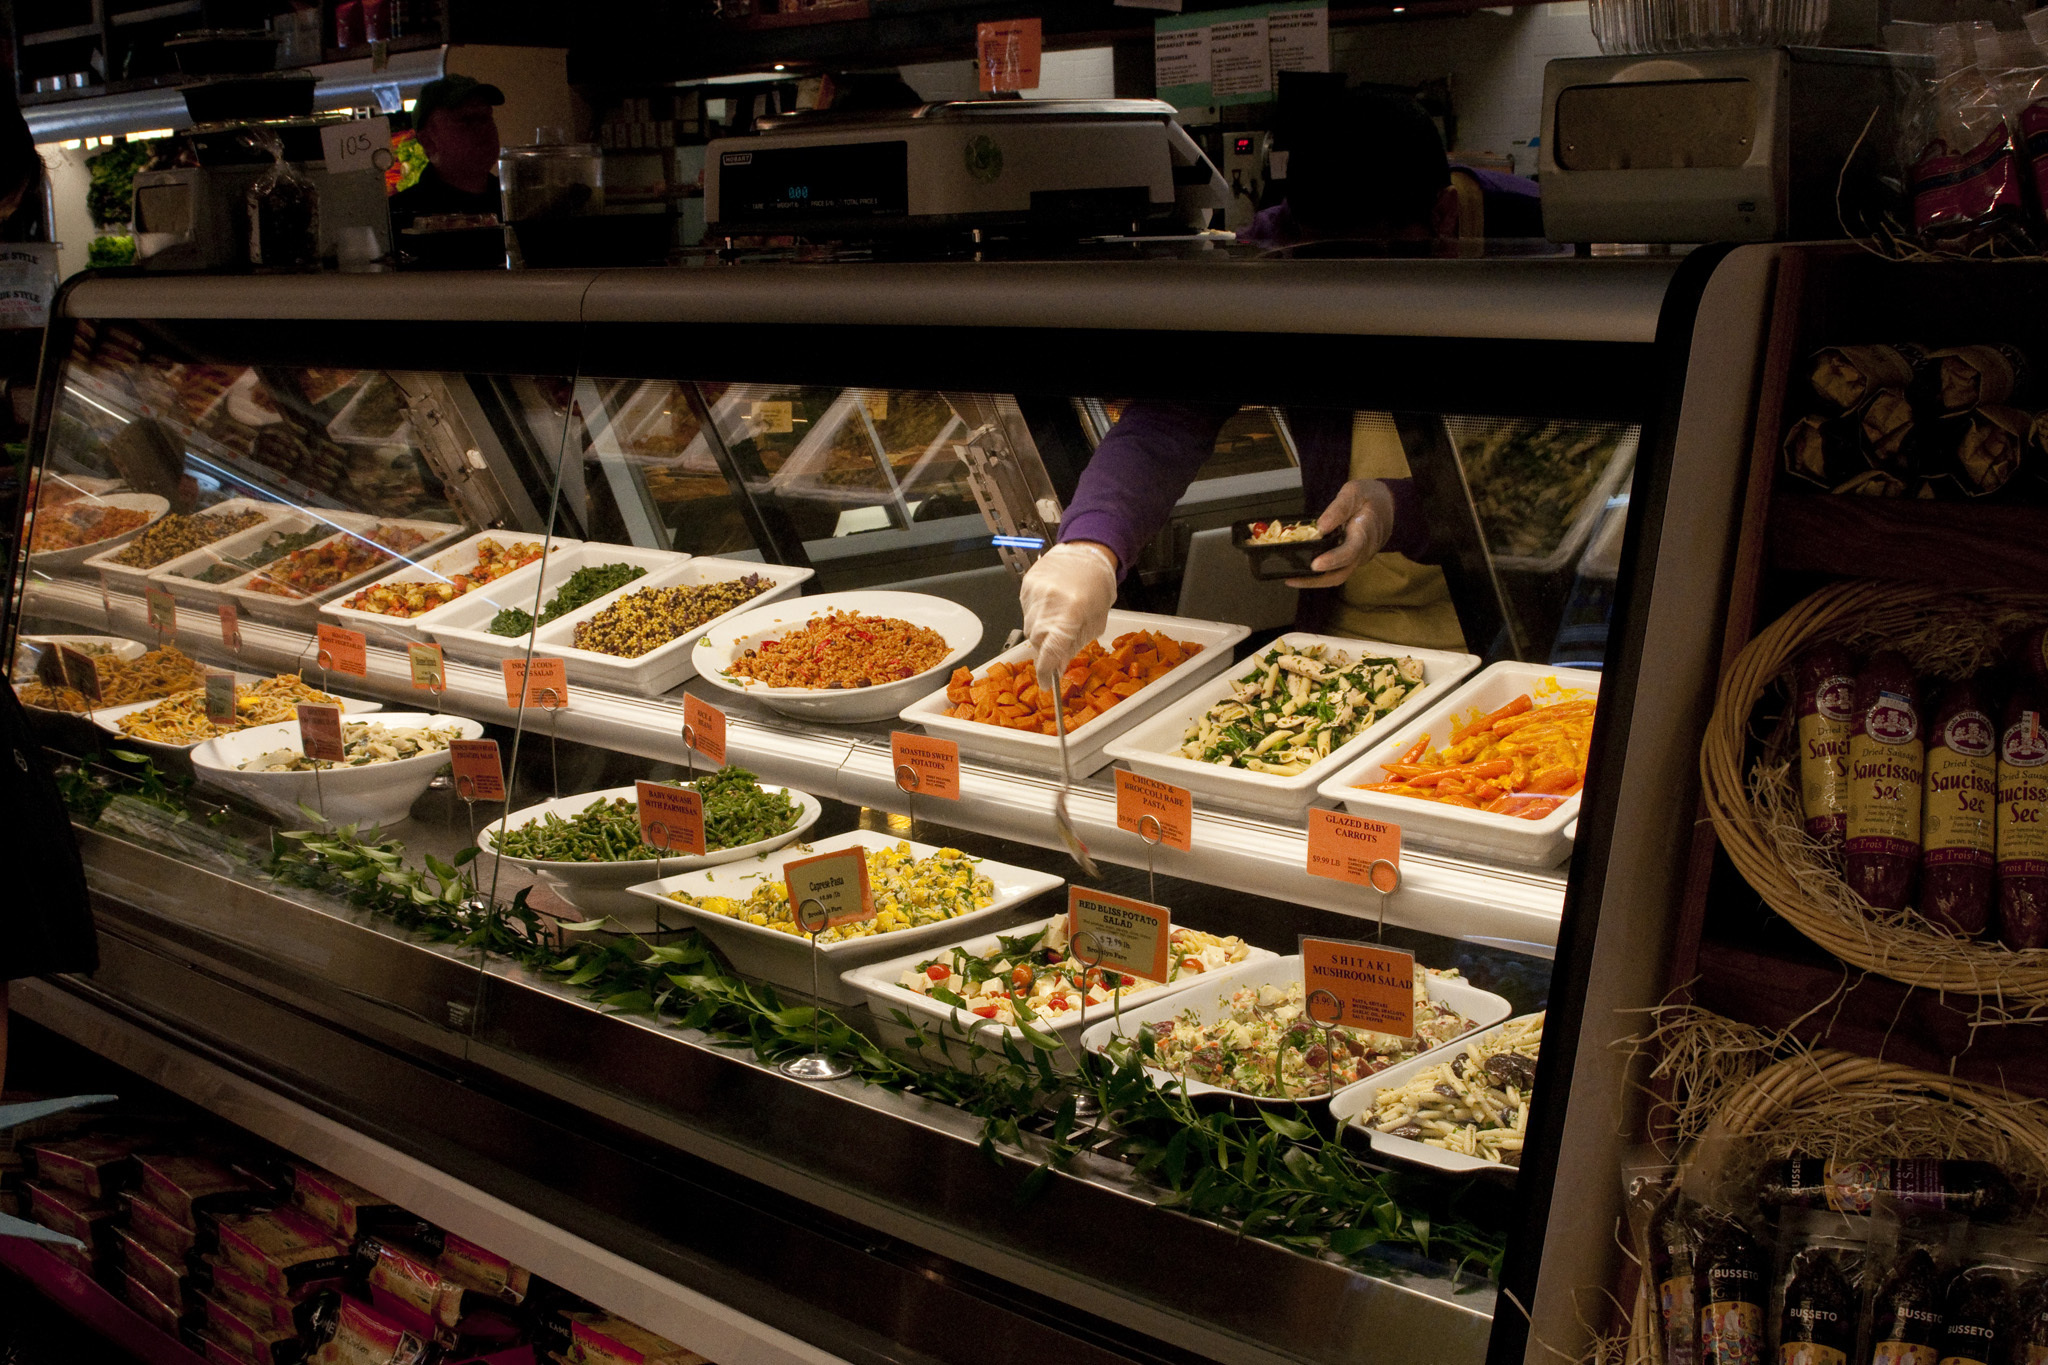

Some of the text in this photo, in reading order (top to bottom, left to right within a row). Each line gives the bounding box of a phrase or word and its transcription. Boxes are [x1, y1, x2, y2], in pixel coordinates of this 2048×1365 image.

[341, 133, 371, 159] 105
[725, 155, 750, 163] HOBART
[11, 252, 39, 264] STYLE
[14, 291, 40, 303] STYLE
[1817, 725, 1841, 736] Dried
[900, 747, 954, 762] ROASTED SWEET
[1808, 735, 1850, 760] Sauci
[1862, 748, 1884, 757] Dried
[911, 758, 945, 770] POTATOES
[1943, 760, 1968, 769] Dried
[1132, 775, 1174, 794] CHICKEN &
[1872, 778, 1901, 801] Sec
[1931, 769, 1997, 796] Saucisso
[649, 790, 692, 805] BABY SQUASH
[1125, 782, 1184, 807] BROCCOLI RABE
[1958, 790, 1985, 814] Sec
[645, 799, 698, 816] WITH PARMESAN
[1143, 797, 1166, 811] PASTA
[2010, 802, 2040, 824] Sec
[1325, 814, 1389, 834] GLAZED BABY
[1335, 827, 1378, 843] CARROTS
[1860, 838, 1882, 849] Trois
[1312, 855, 1341, 867] $9.99 LB
[1930, 852, 1943, 861] Les
[1946, 849, 1971, 860] Trois
[2025, 861, 2047, 873] Petit
[809, 877, 844, 892] Caprese Pasta
[1079, 899, 1158, 926] RED BLISS POTATO
[1103, 915, 1133, 929] SALAD
[1114, 952, 1127, 960] Fare
[1332, 954, 1391, 973] SHITAKI
[1313, 965, 1413, 990] MUSHROOM SALAD
[1791, 1159, 1800, 1195] BUSSET
[1667, 1244, 1695, 1255] BUSS
[1713, 1268, 1759, 1281] BUSSETO
[1790, 1307, 1838, 1322] BUSSETO
[1897, 1306, 1944, 1324] BUSSETO
